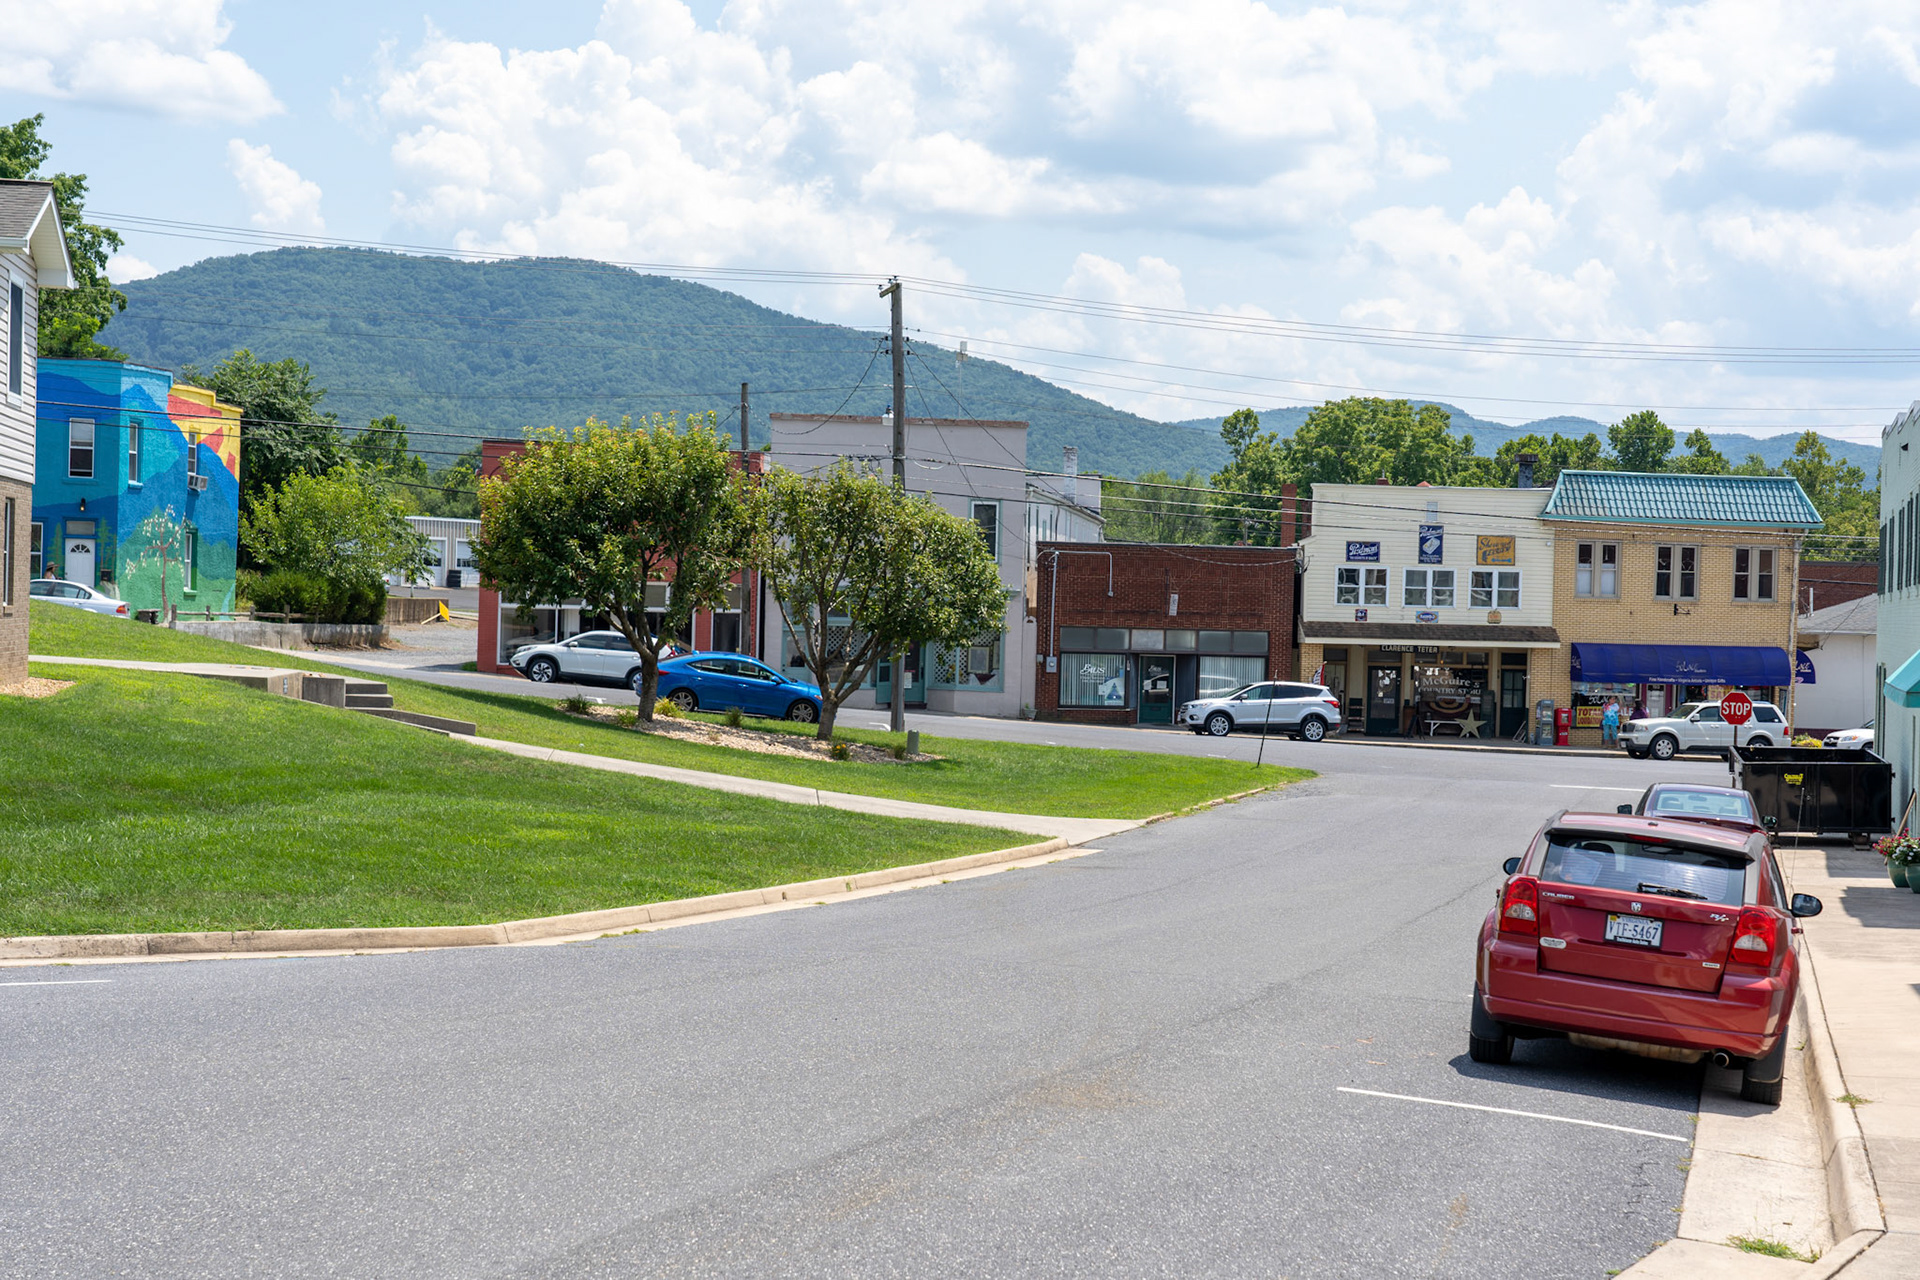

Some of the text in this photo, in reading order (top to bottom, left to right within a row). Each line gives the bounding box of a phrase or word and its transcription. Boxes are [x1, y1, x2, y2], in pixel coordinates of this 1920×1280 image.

[1381, 644, 1438, 654] CLARENCE TETER
[1422, 676, 1480, 688] McGuires
[1722, 702, 1751, 715] STOP
[1542, 891, 1575, 900] CALIBER
[1608, 921, 1659, 940] VTF-5467
